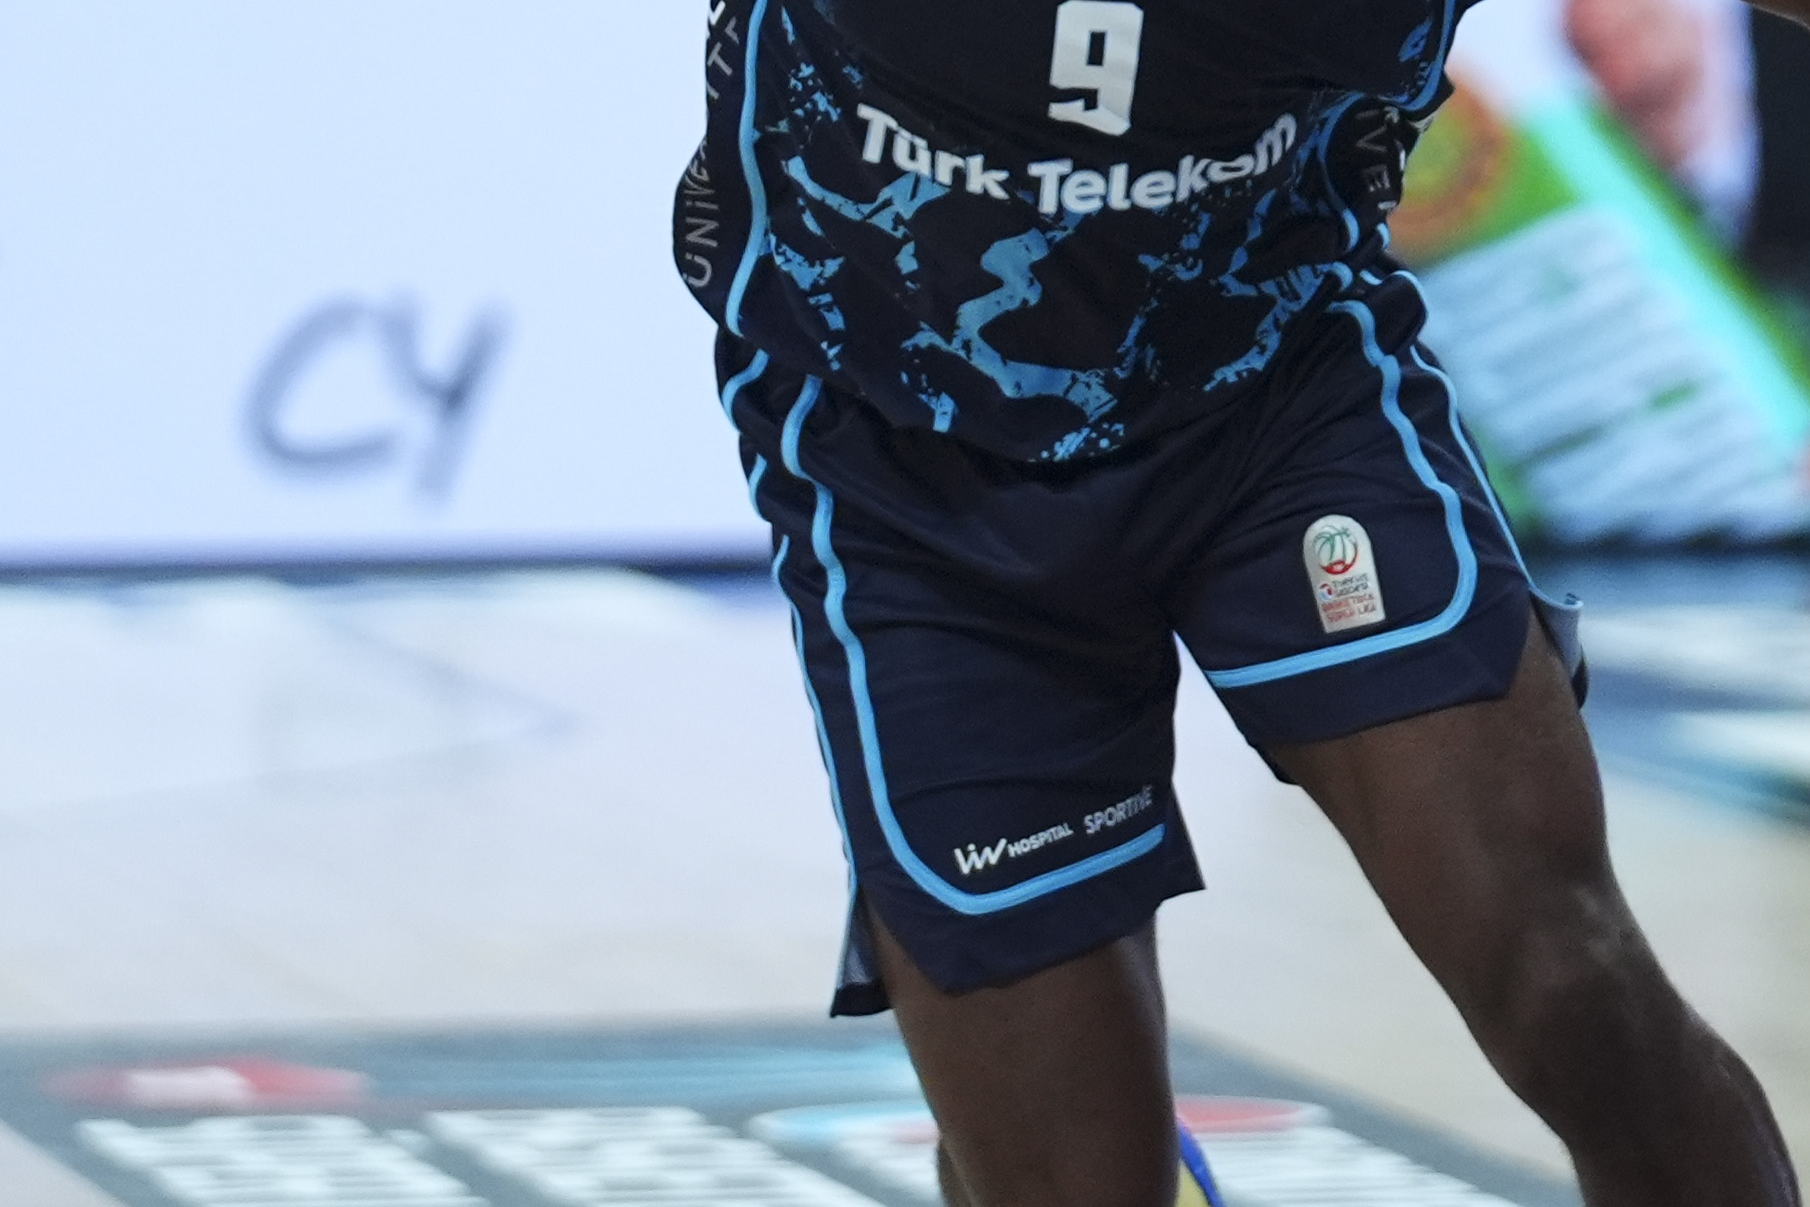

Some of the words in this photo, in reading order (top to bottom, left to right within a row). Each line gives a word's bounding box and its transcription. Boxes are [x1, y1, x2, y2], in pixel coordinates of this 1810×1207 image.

[857, 103, 1010, 200] Türk
[1027, 113, 1298, 215] Telekom
[1007, 822, 1074, 858] HOSPITAL
[1084, 784, 1153, 834] SPORTIVE
